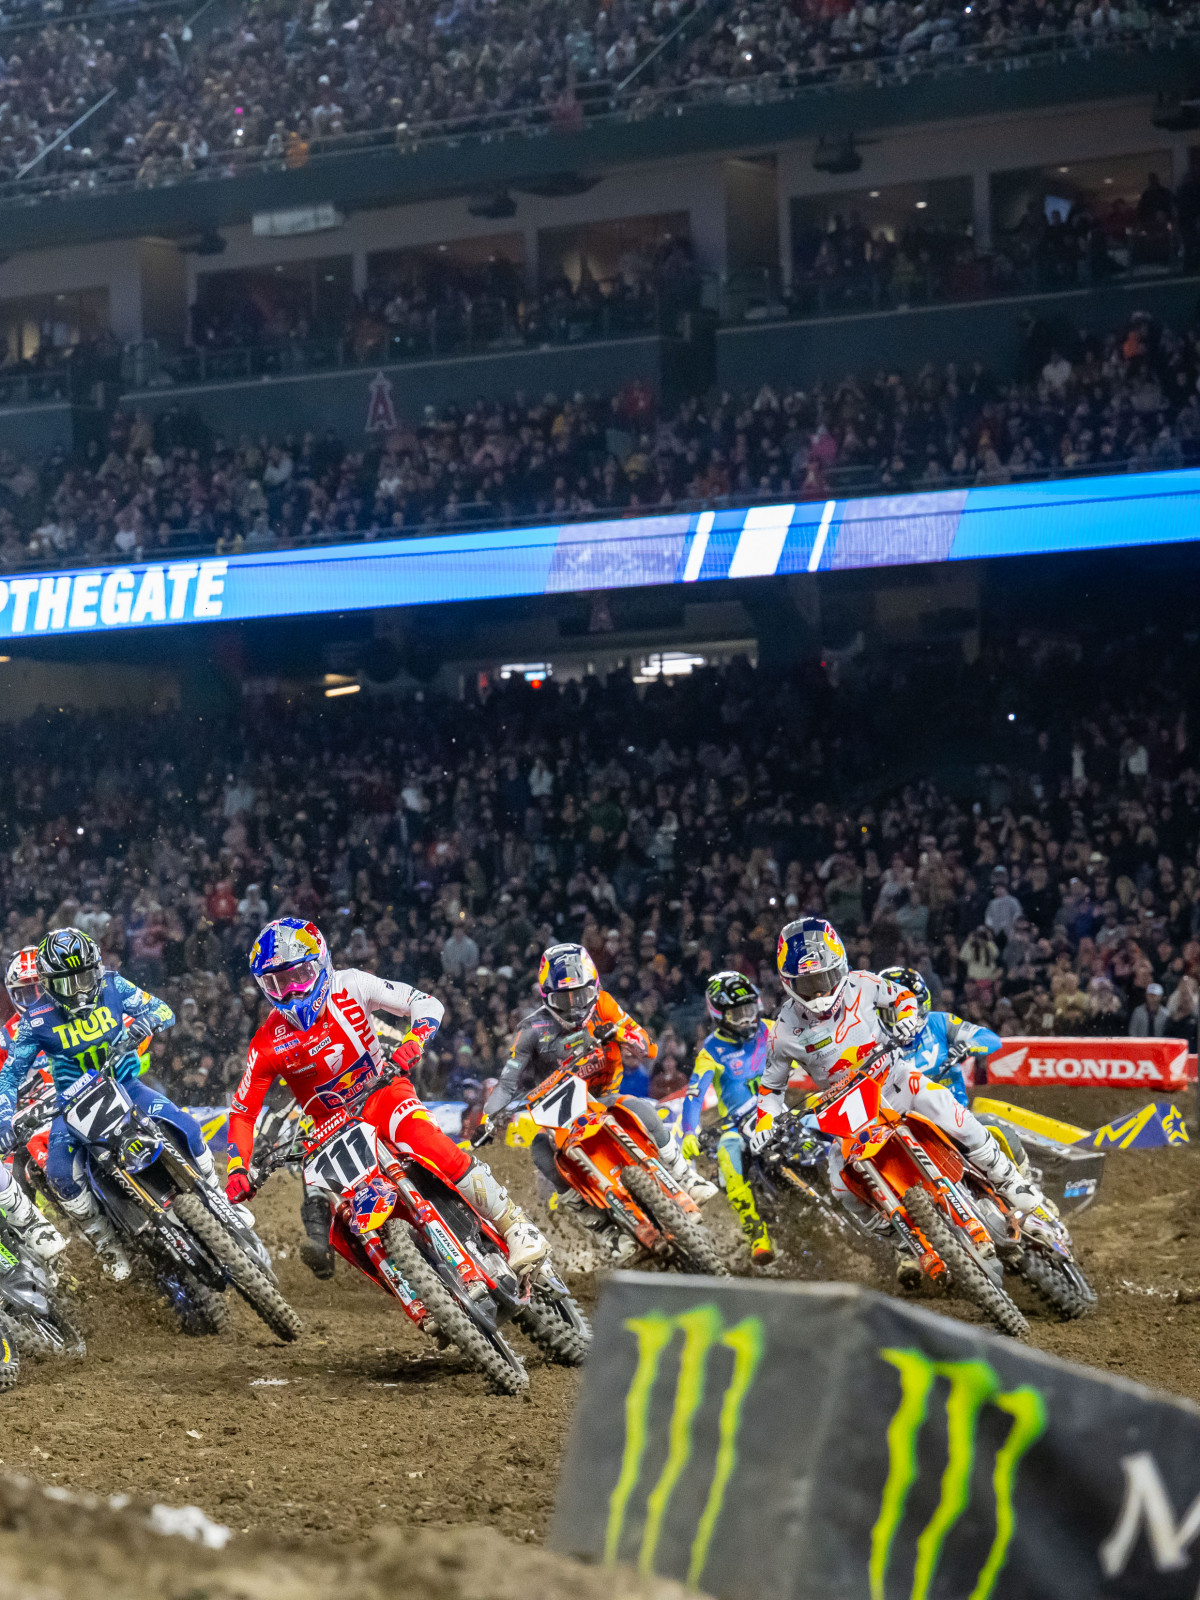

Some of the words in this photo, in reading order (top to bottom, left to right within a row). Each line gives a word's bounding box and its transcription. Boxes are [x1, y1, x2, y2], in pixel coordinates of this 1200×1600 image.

[52, 1006, 118, 1049] THOR
[331, 987, 376, 1053] THOR
[311, 1037, 331, 1056] AIROH
[1028, 1057, 1163, 1080] HONDA
[74, 1078, 131, 1138] 2
[542, 1079, 576, 1128] 7
[838, 1087, 869, 1133] 1
[314, 1126, 377, 1195] 111
[206, 1190, 246, 1229] DUNLOP
[435, 1228, 460, 1258] DUNLOP
